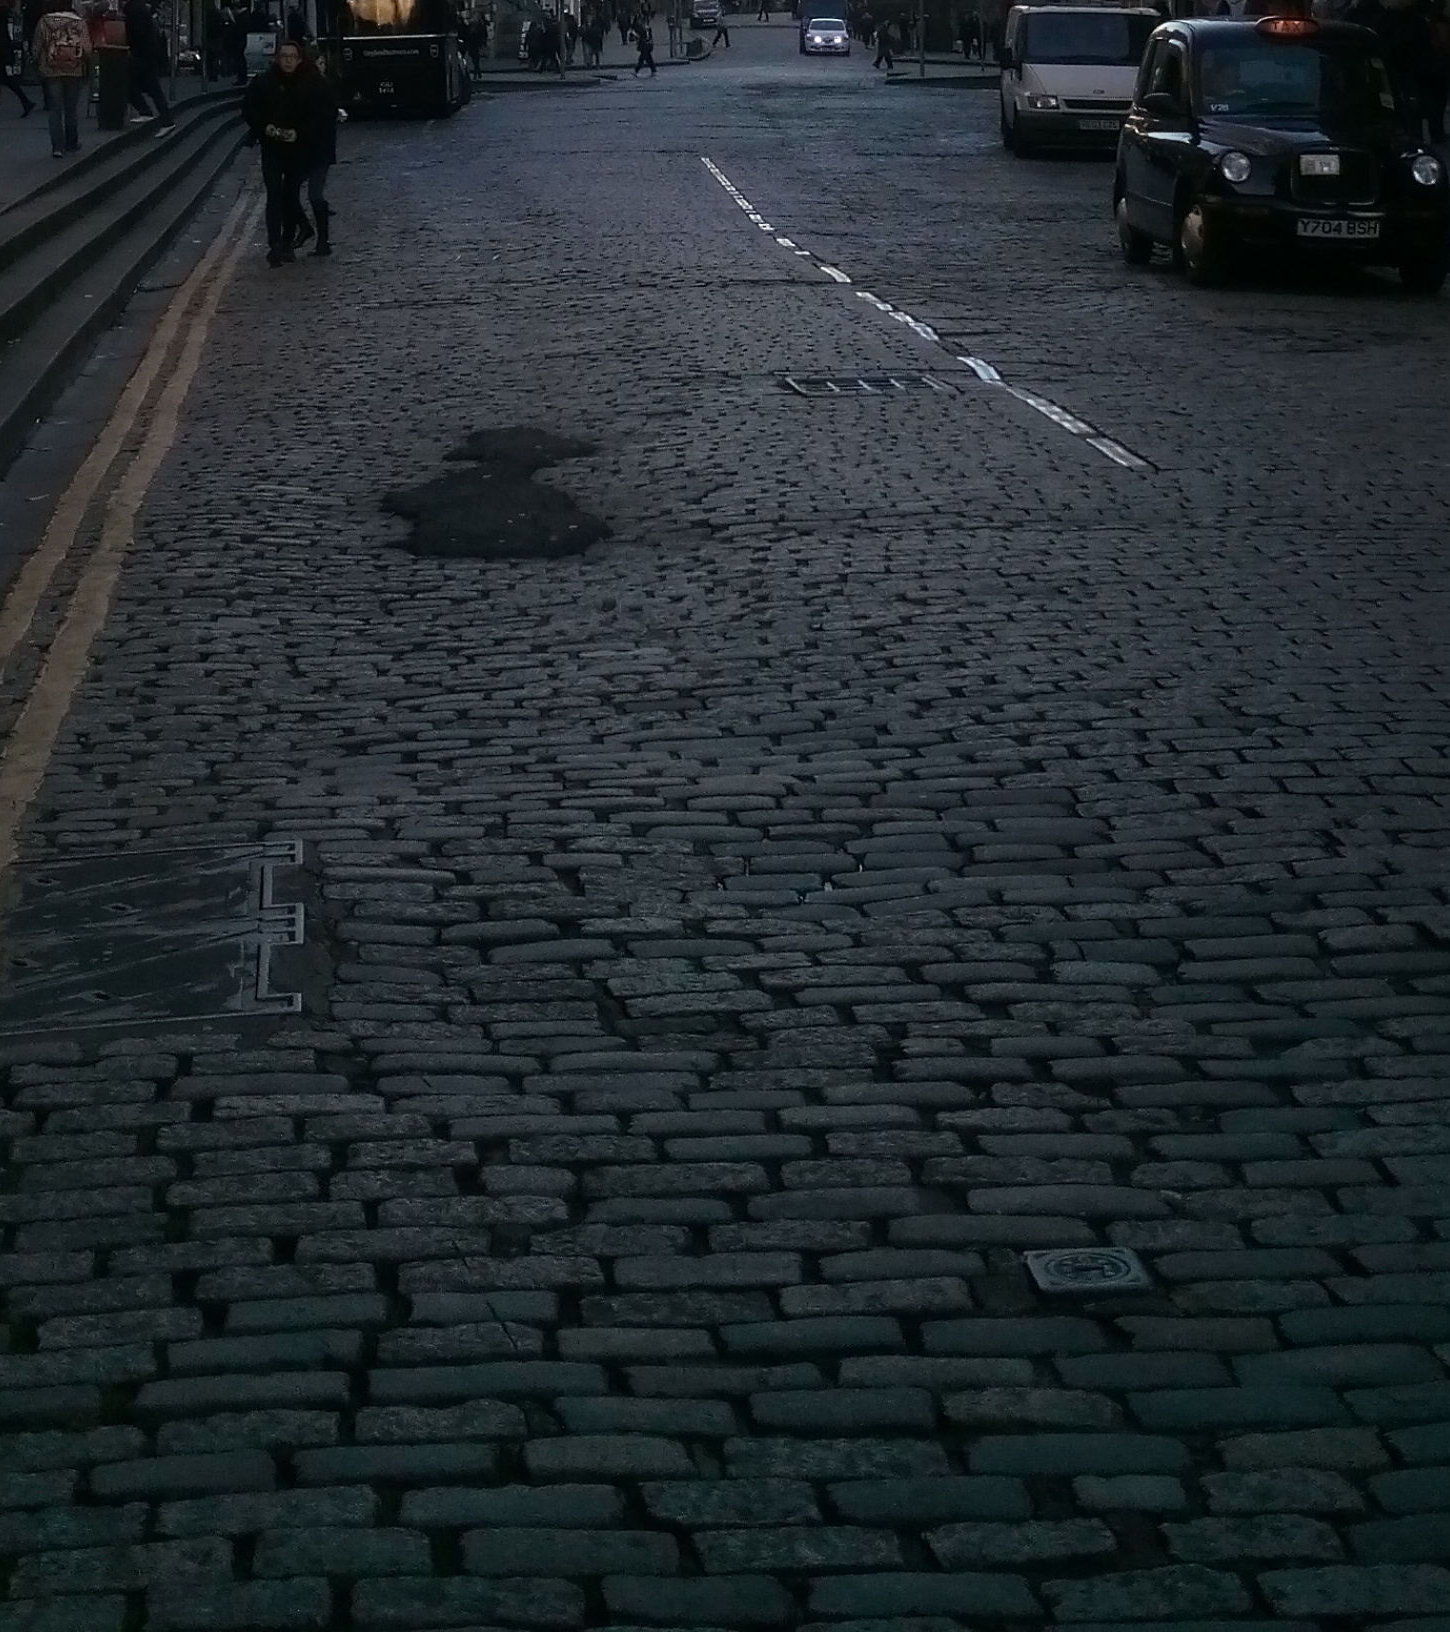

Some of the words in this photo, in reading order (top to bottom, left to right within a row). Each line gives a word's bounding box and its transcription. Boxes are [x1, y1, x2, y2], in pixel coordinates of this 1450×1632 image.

[1272, 22, 1307, 33] TAXI
[1299, 219, 1342, 235] Y704
[1346, 221, 1378, 235] BSH
